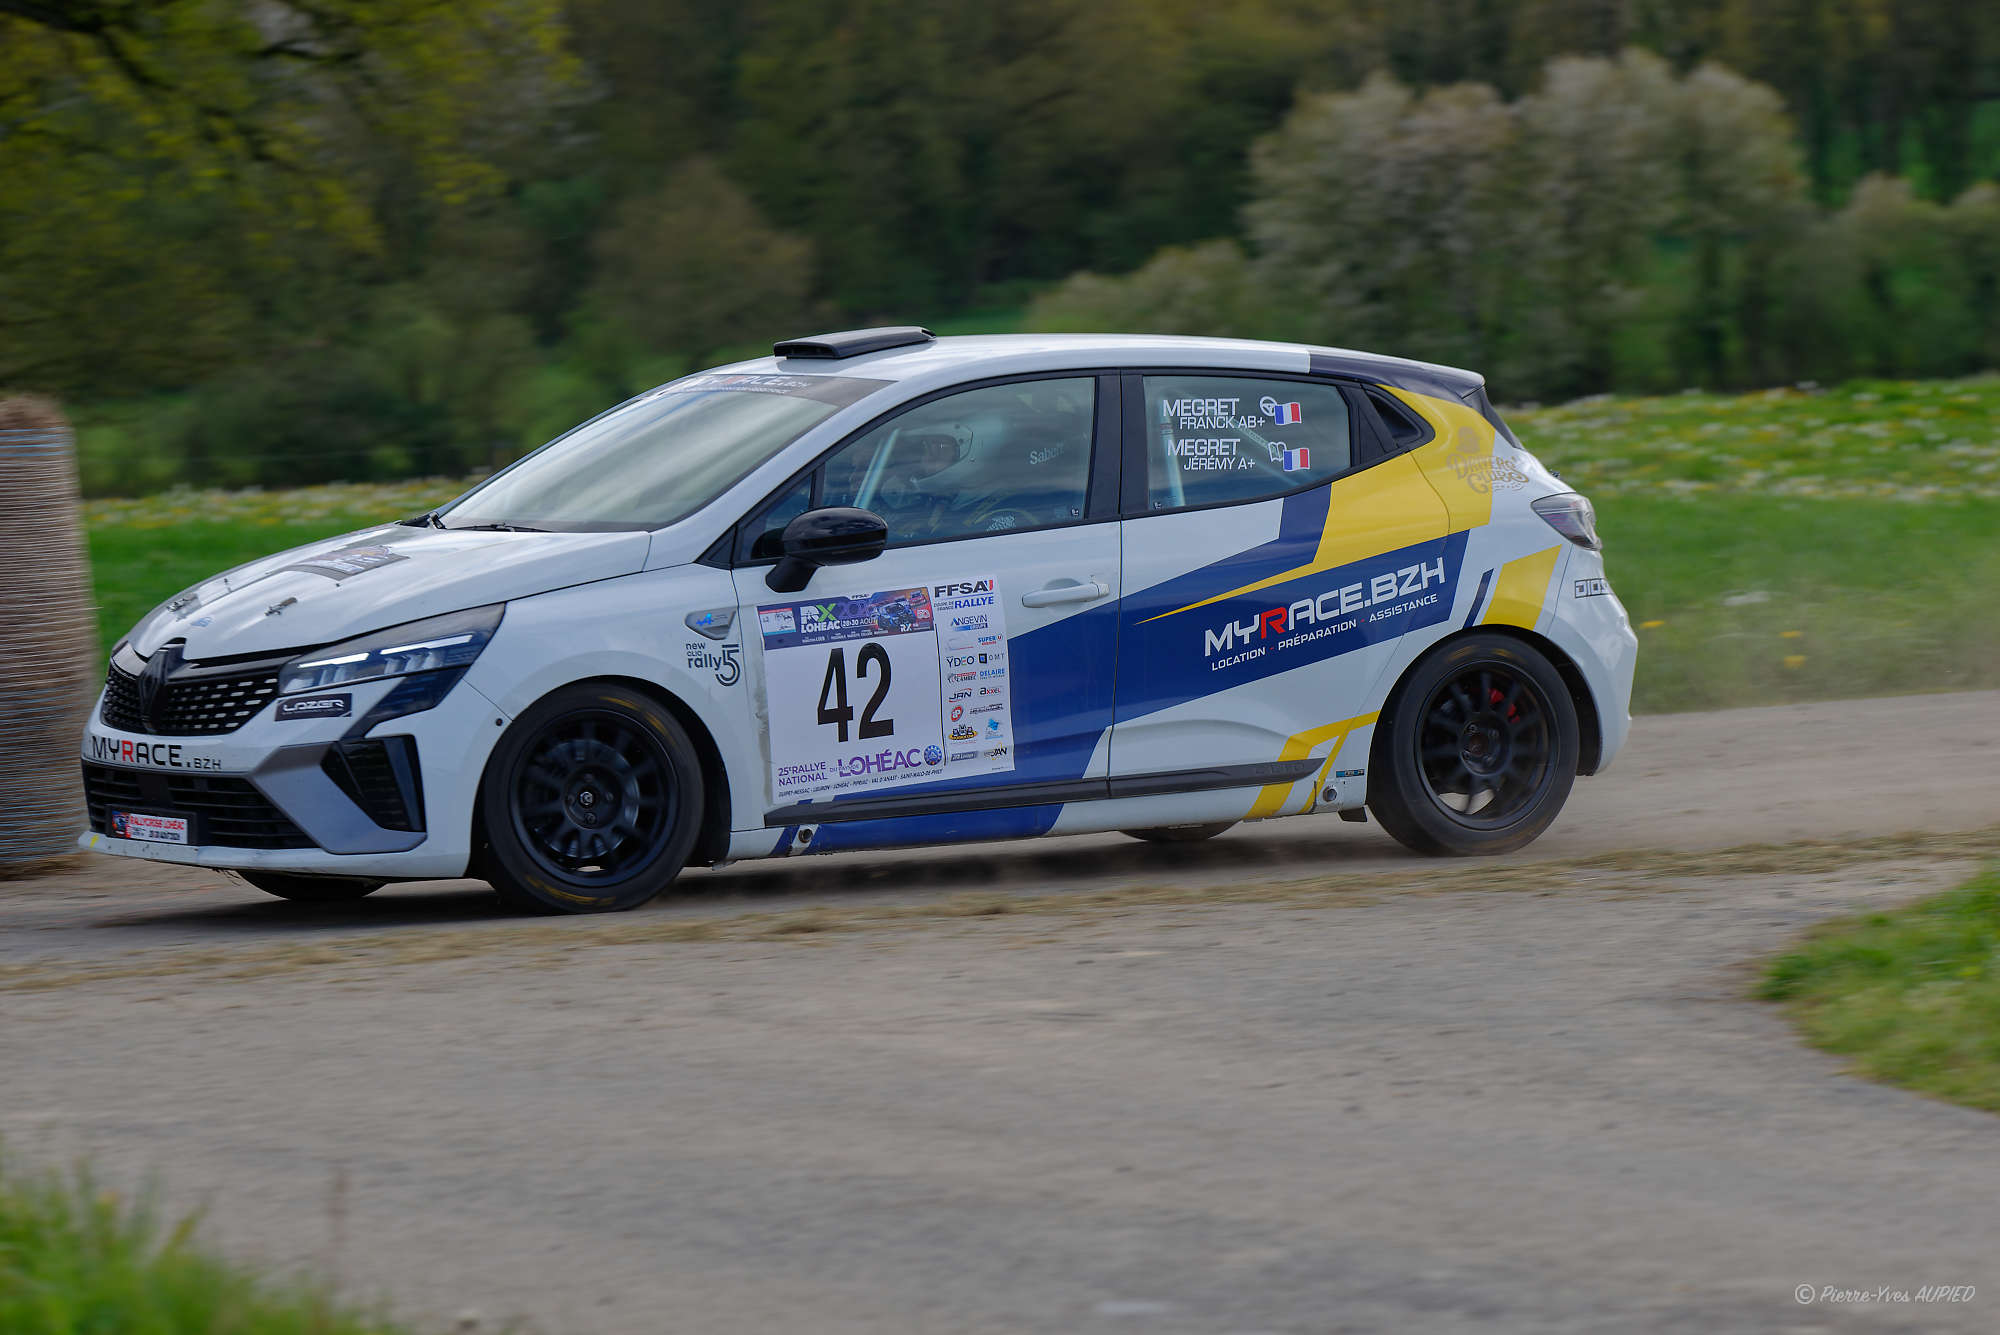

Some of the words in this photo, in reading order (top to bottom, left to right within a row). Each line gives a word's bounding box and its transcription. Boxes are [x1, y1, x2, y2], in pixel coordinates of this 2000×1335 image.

[1163, 398, 1239, 417] MEGRET
[1180, 416, 1236, 430] FRANCK
[1238, 416, 1265, 429] AB+
[1168, 438, 1240, 456] MEGRET
[1184, 455, 1237, 471] JÉRÉMY
[1238, 457, 1256, 470] A+
[934, 580, 989, 598] FFSA
[955, 596, 994, 609] RALLYE
[1204, 557, 1446, 657] MYRACE.BZH
[801, 620, 841, 633] LOHEAC
[1212, 646, 1266, 671] LOCATION
[1278, 618, 1357, 651] PRÉPARATION
[1369, 594, 1438, 623] ASSISTANCE
[686, 642, 706, 650] new
[817, 642, 894, 742] 42
[837, 748, 922, 778] LOHÉAC
[778, 771, 829, 786] NATIONAL
